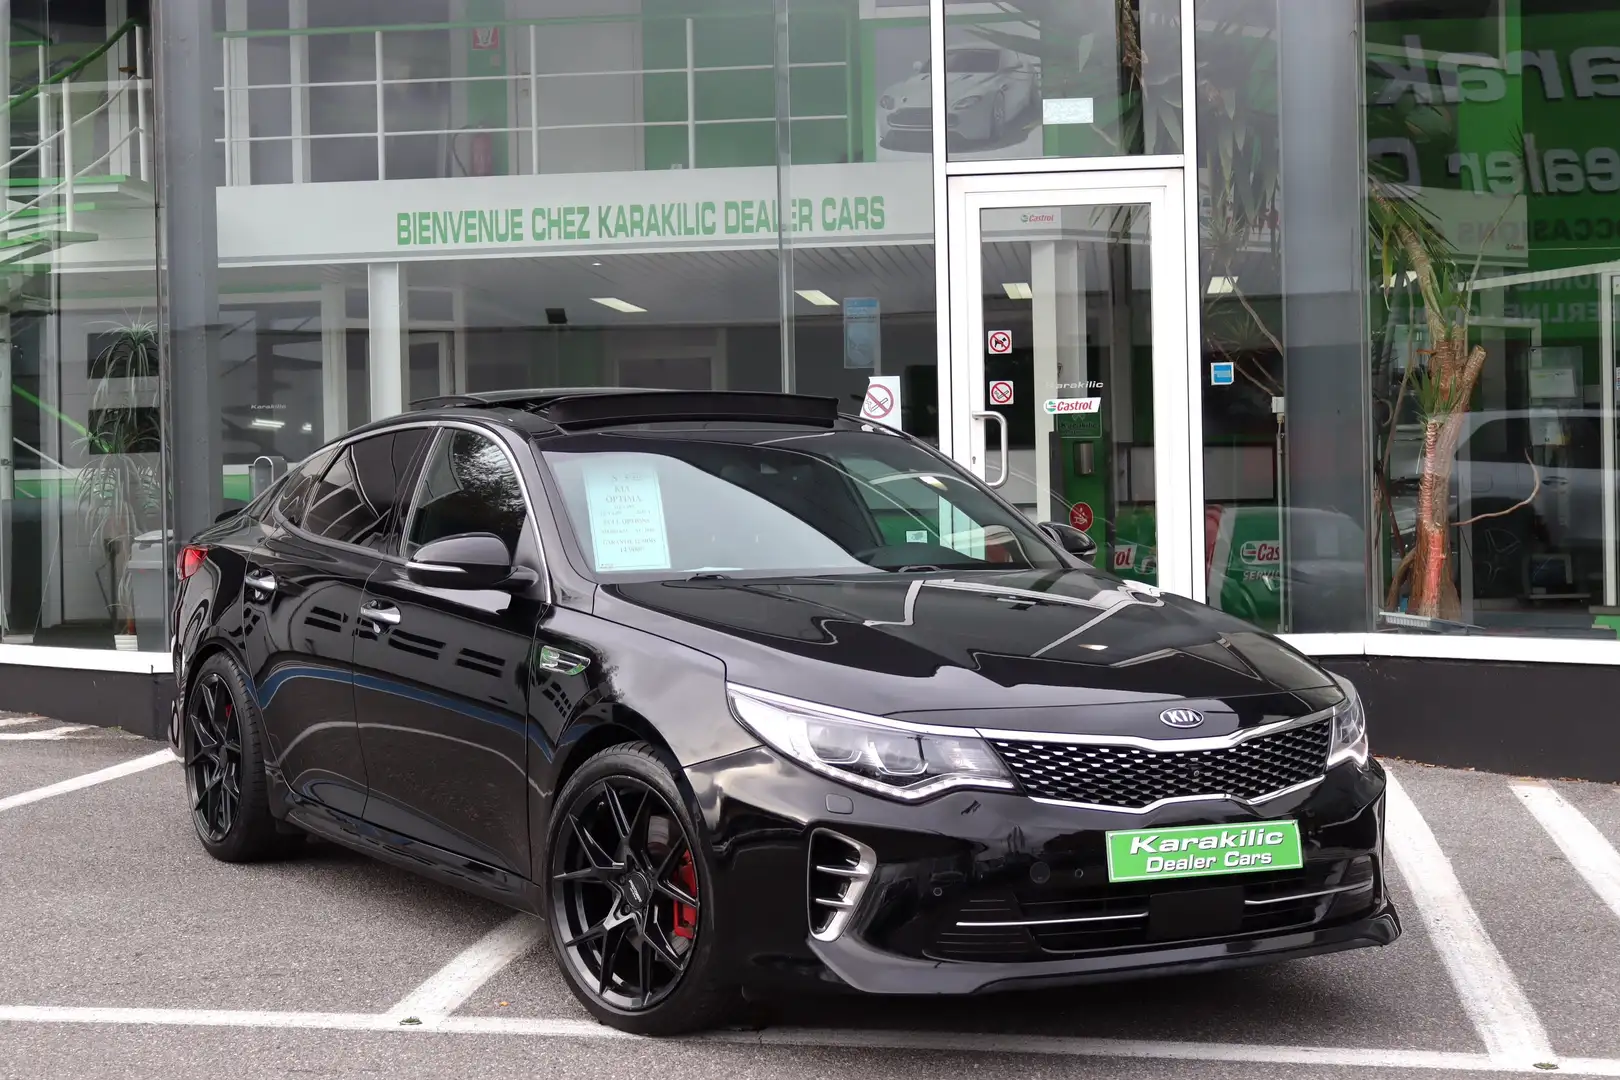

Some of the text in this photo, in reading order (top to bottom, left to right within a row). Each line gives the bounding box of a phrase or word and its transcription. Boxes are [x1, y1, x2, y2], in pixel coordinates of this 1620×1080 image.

[397, 195, 885, 245] BIENVENUE CHEZ KARAKILIC DEALER CARS
[1057, 401, 1093, 412] Castrol
[1167, 710, 1201, 723] KIA
[1130, 829, 1284, 855] Karakilic
[1146, 851, 1272, 873] Dealer Cars
